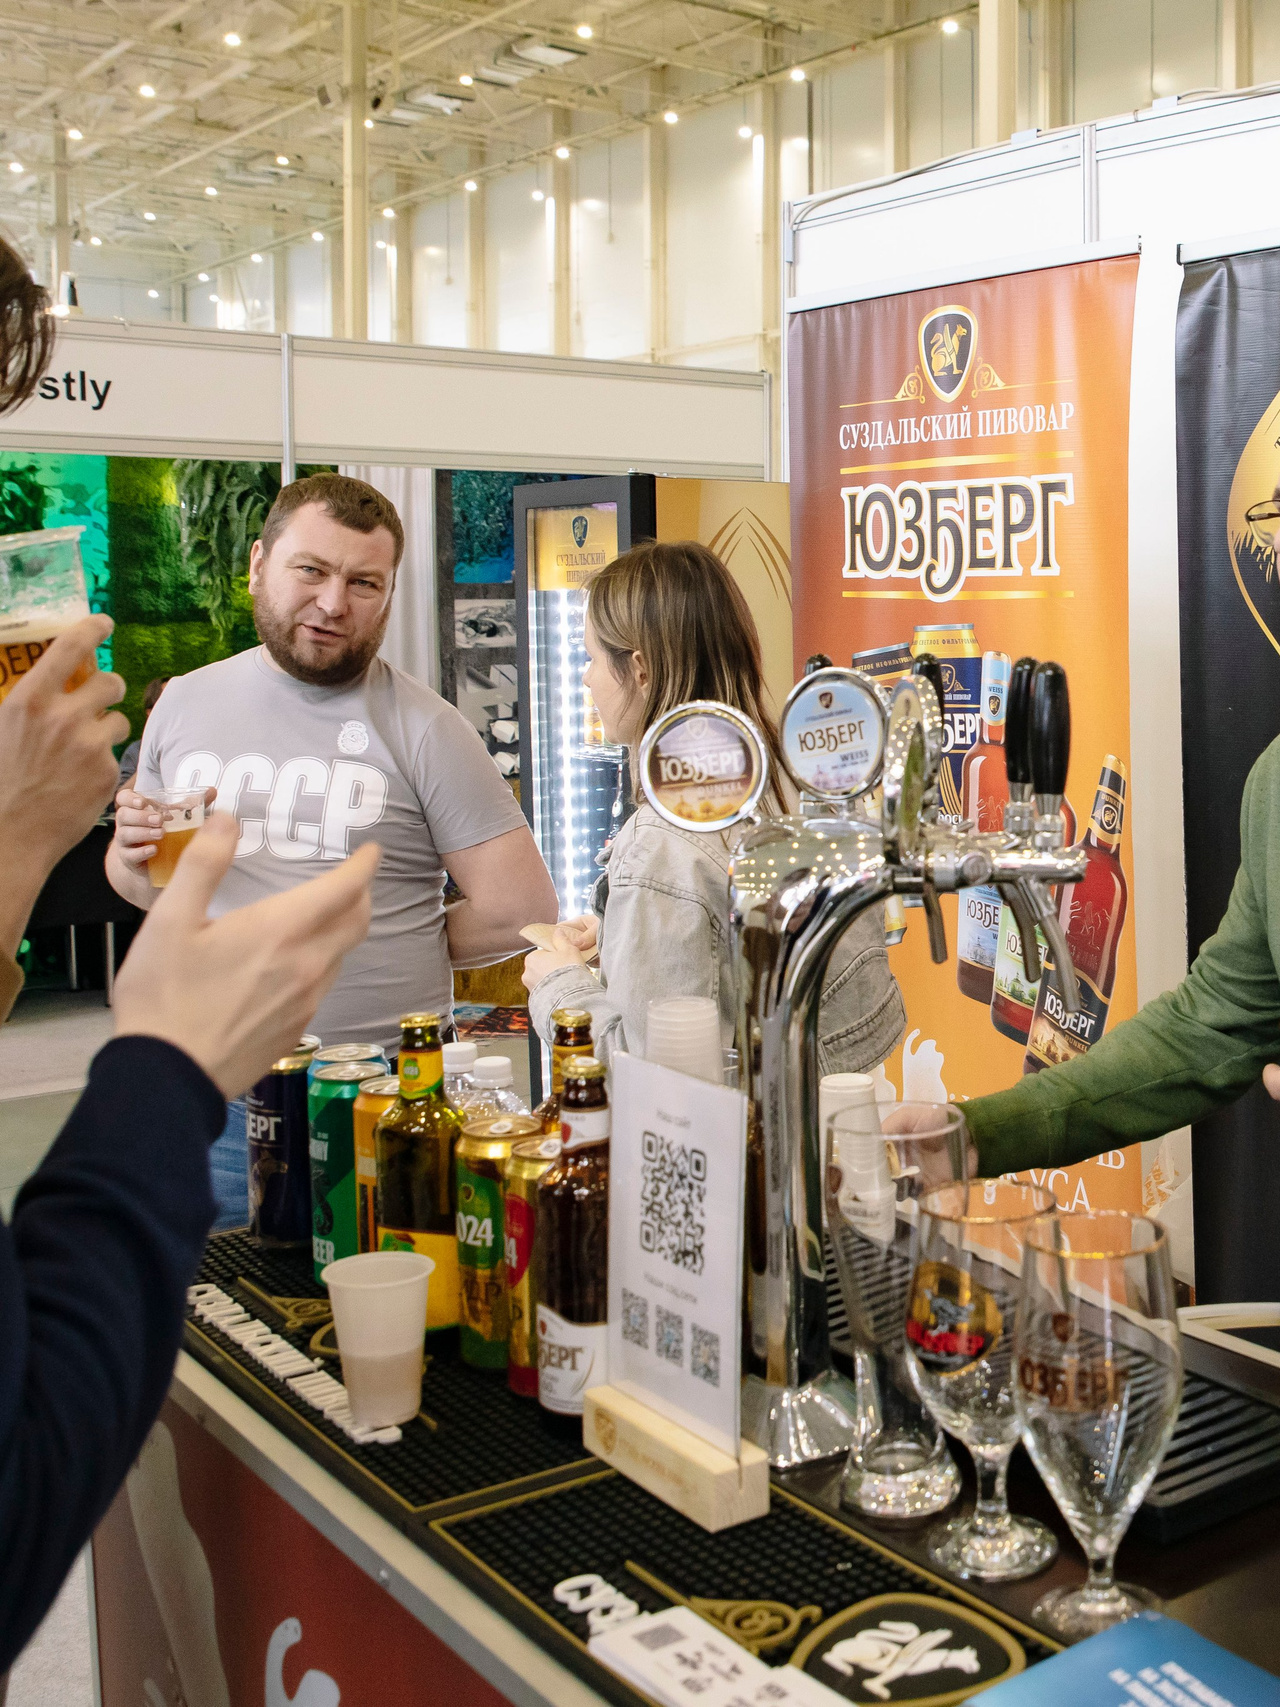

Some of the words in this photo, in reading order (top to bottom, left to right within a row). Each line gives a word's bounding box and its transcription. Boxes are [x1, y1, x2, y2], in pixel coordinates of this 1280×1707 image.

[38, 370, 112, 410] stly
[839, 406, 971, 450] СУЗДАЛЬСКИЙ
[977, 402, 1075, 436] ПИВОВАР
[840, 473, 1075, 603] ЮЗБЕРГ
[797, 720, 865, 753] ЮЗБЕРГ
[658, 749, 742, 784] ЮЗБЕРГ
[966, 898, 999, 930] ЮЗБЕ
[247, 1110, 282, 1141] ЕРГ
